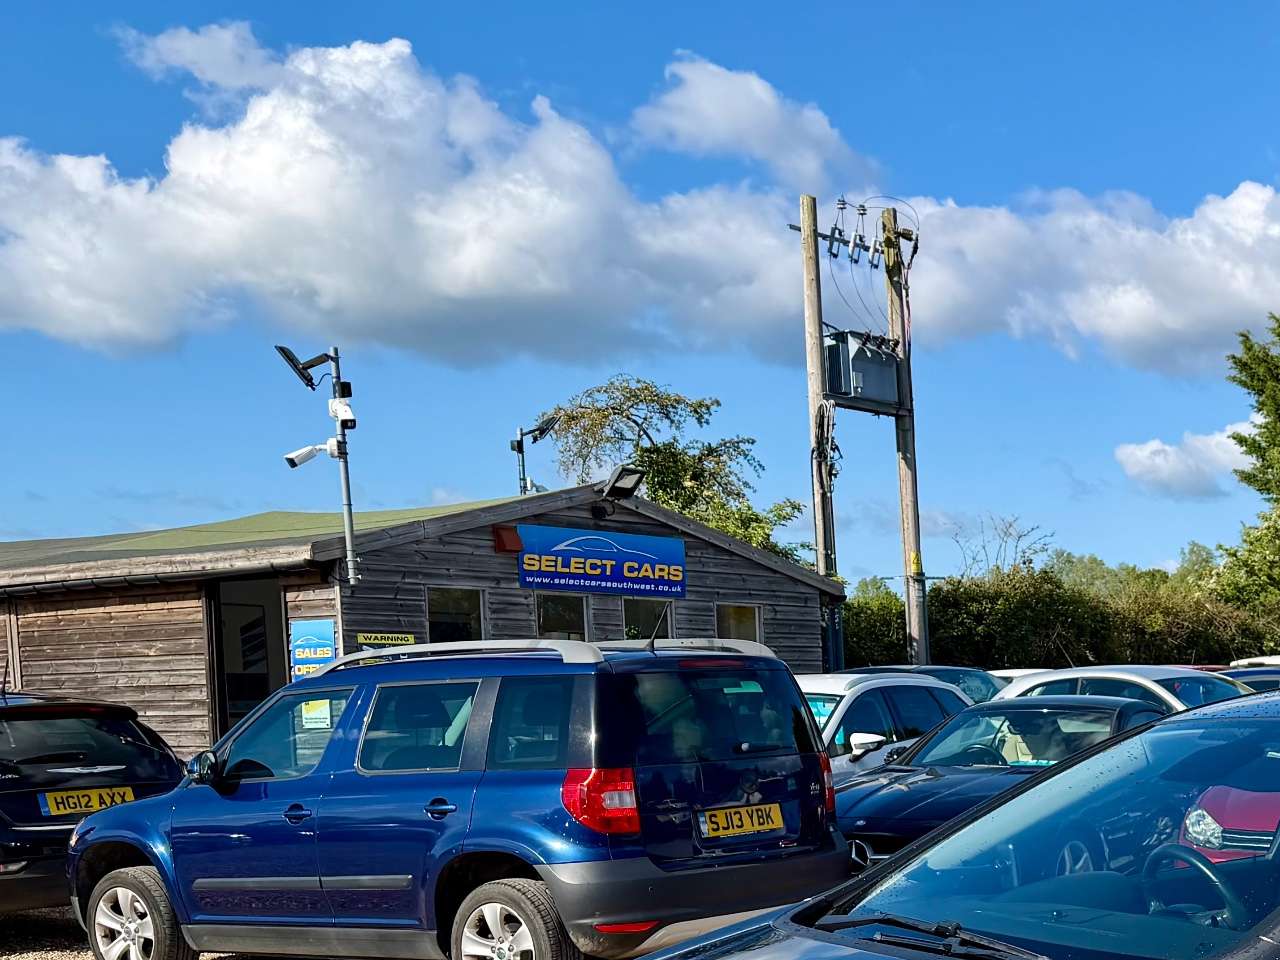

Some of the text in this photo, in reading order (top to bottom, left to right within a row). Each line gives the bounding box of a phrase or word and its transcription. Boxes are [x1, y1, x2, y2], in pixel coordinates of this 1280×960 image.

[522, 554, 684, 581] SELECT CARS
[525, 576, 682, 593] www.selectcarssouthwest.co.uk
[362, 634, 410, 643] WARNING
[295, 647, 332, 659] SALES
[54, 791, 127, 811] HG12 AXX
[708, 806, 775, 832] SJ13 YBK
